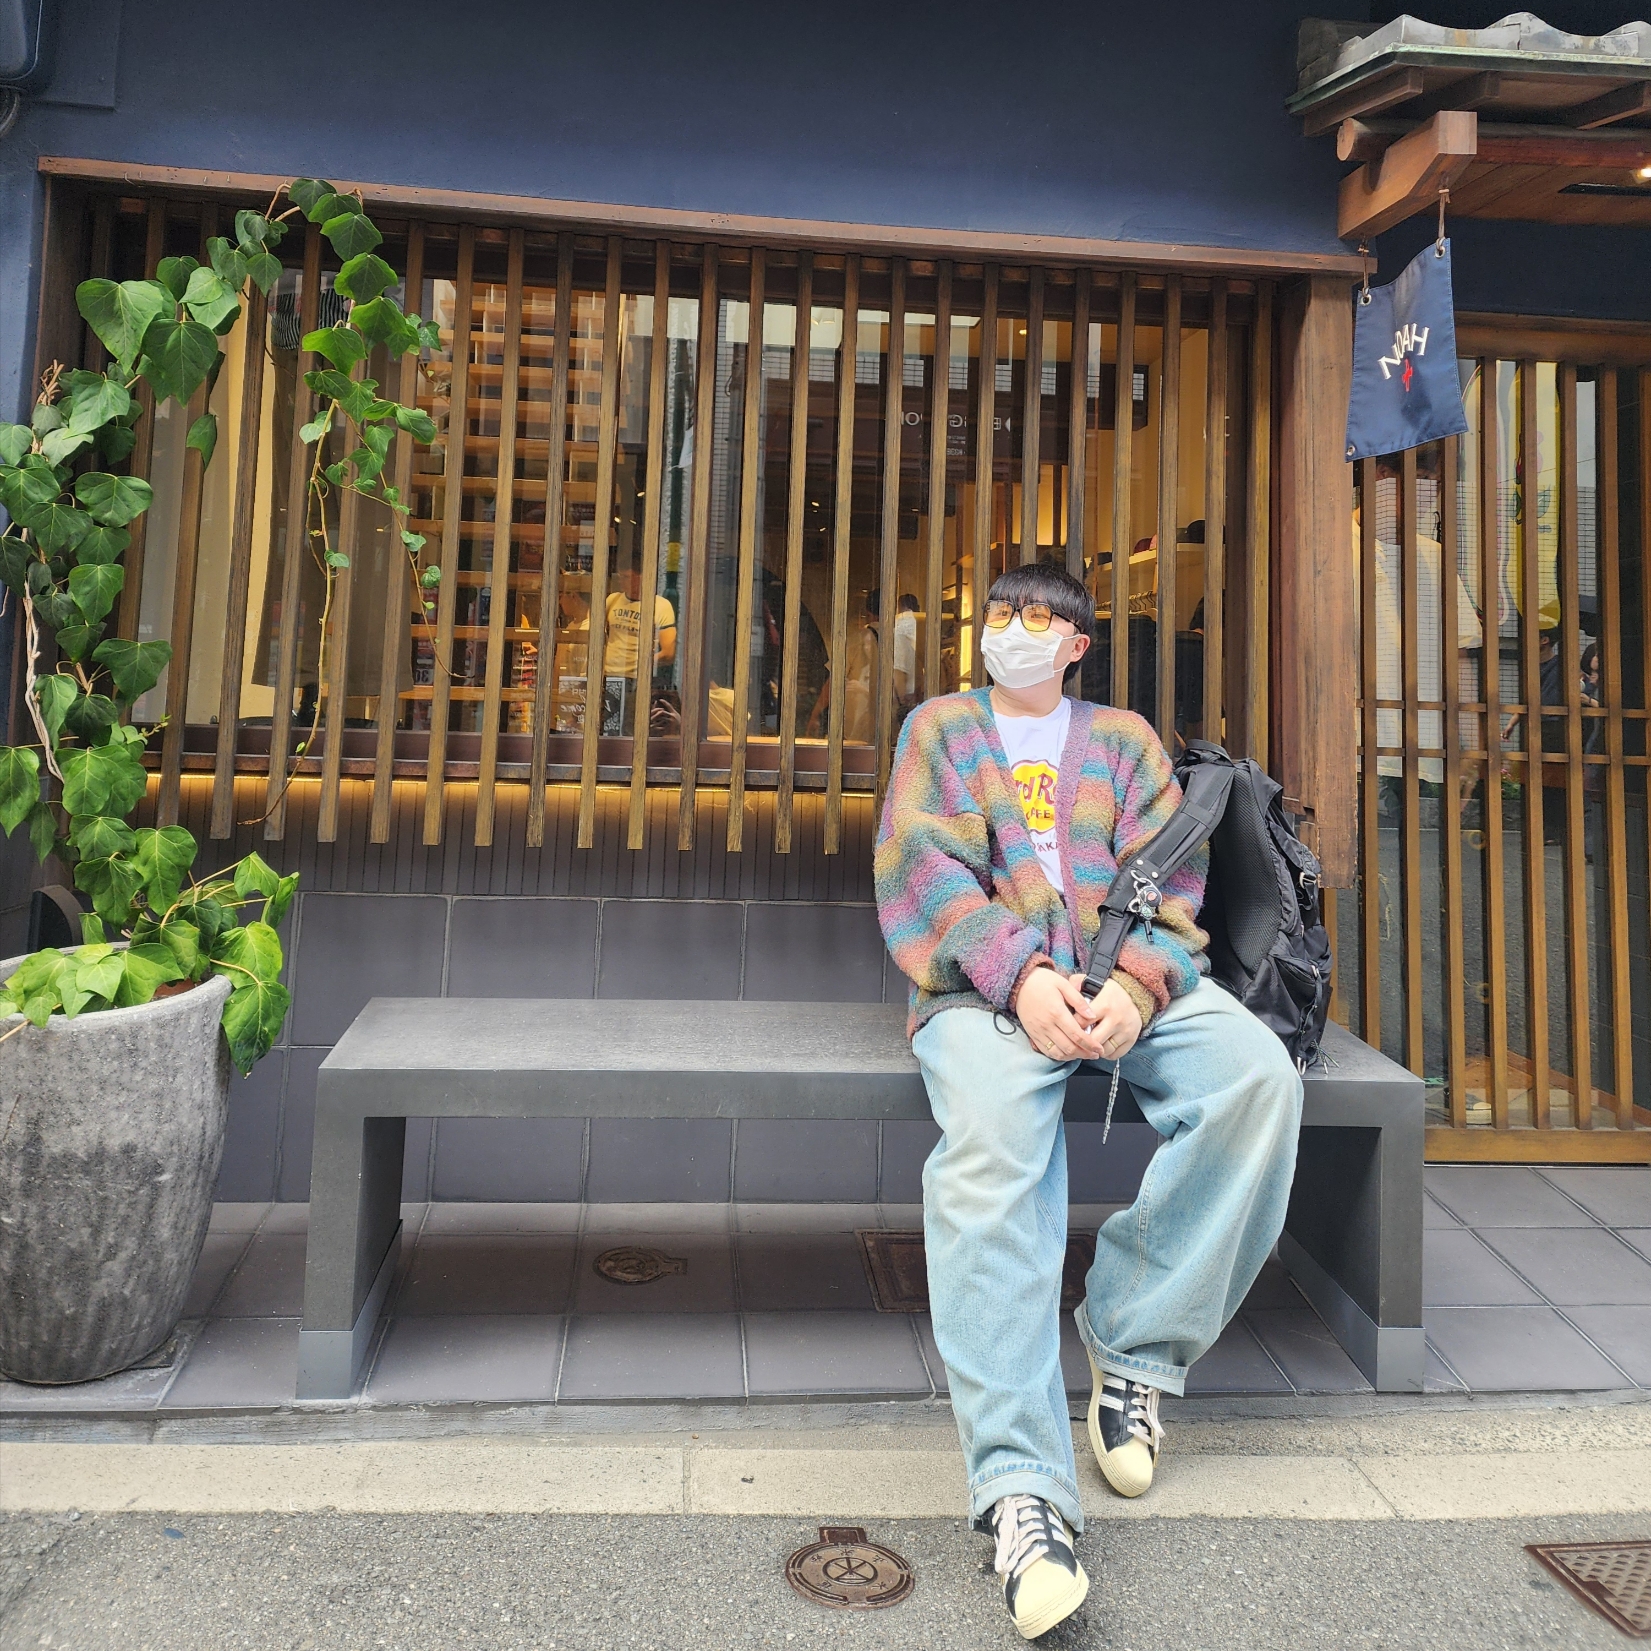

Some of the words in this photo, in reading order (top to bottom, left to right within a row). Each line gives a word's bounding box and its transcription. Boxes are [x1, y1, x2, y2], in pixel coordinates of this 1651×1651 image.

[1377, 322, 1430, 379] NOAH
[1014, 776, 1036, 800] rd
[1025, 806, 1051, 821] CAFE
